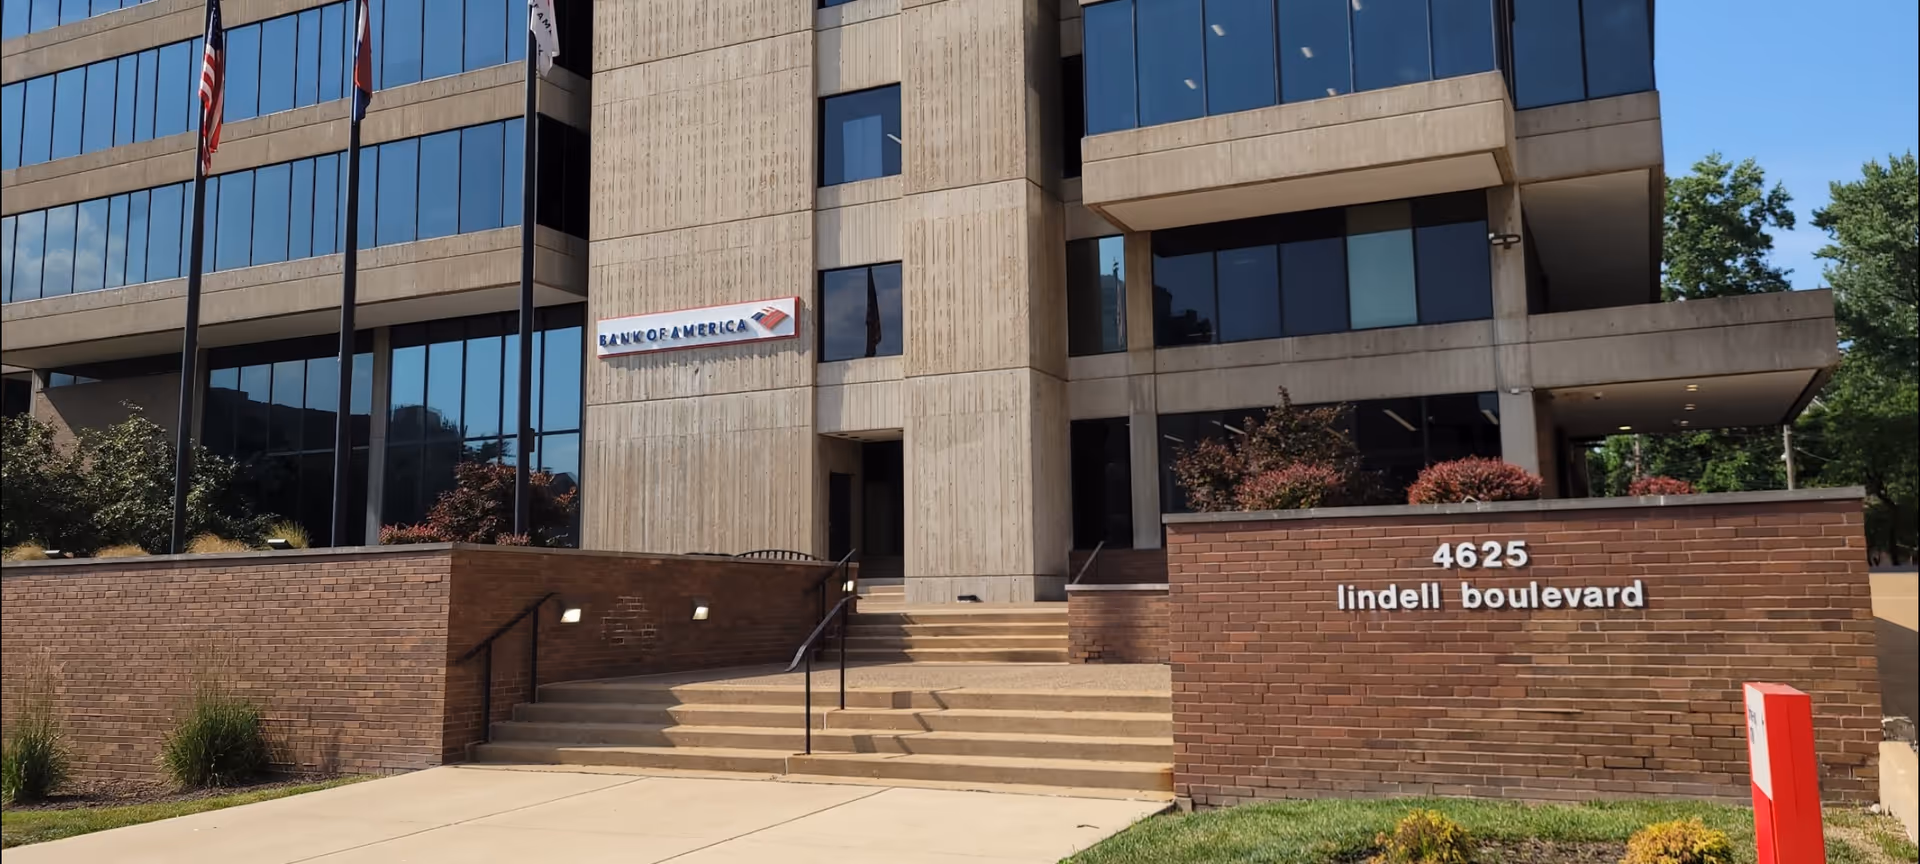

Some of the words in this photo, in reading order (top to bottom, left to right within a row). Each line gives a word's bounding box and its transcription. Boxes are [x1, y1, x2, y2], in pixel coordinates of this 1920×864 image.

[599, 331, 641, 347] BANK
[646, 327, 666, 341] OF
[670, 318, 747, 339] AMERICA
[1432, 540, 1529, 569] 4625
[1337, 582, 1441, 610] lindell
[1460, 579, 1644, 609] boulevard
